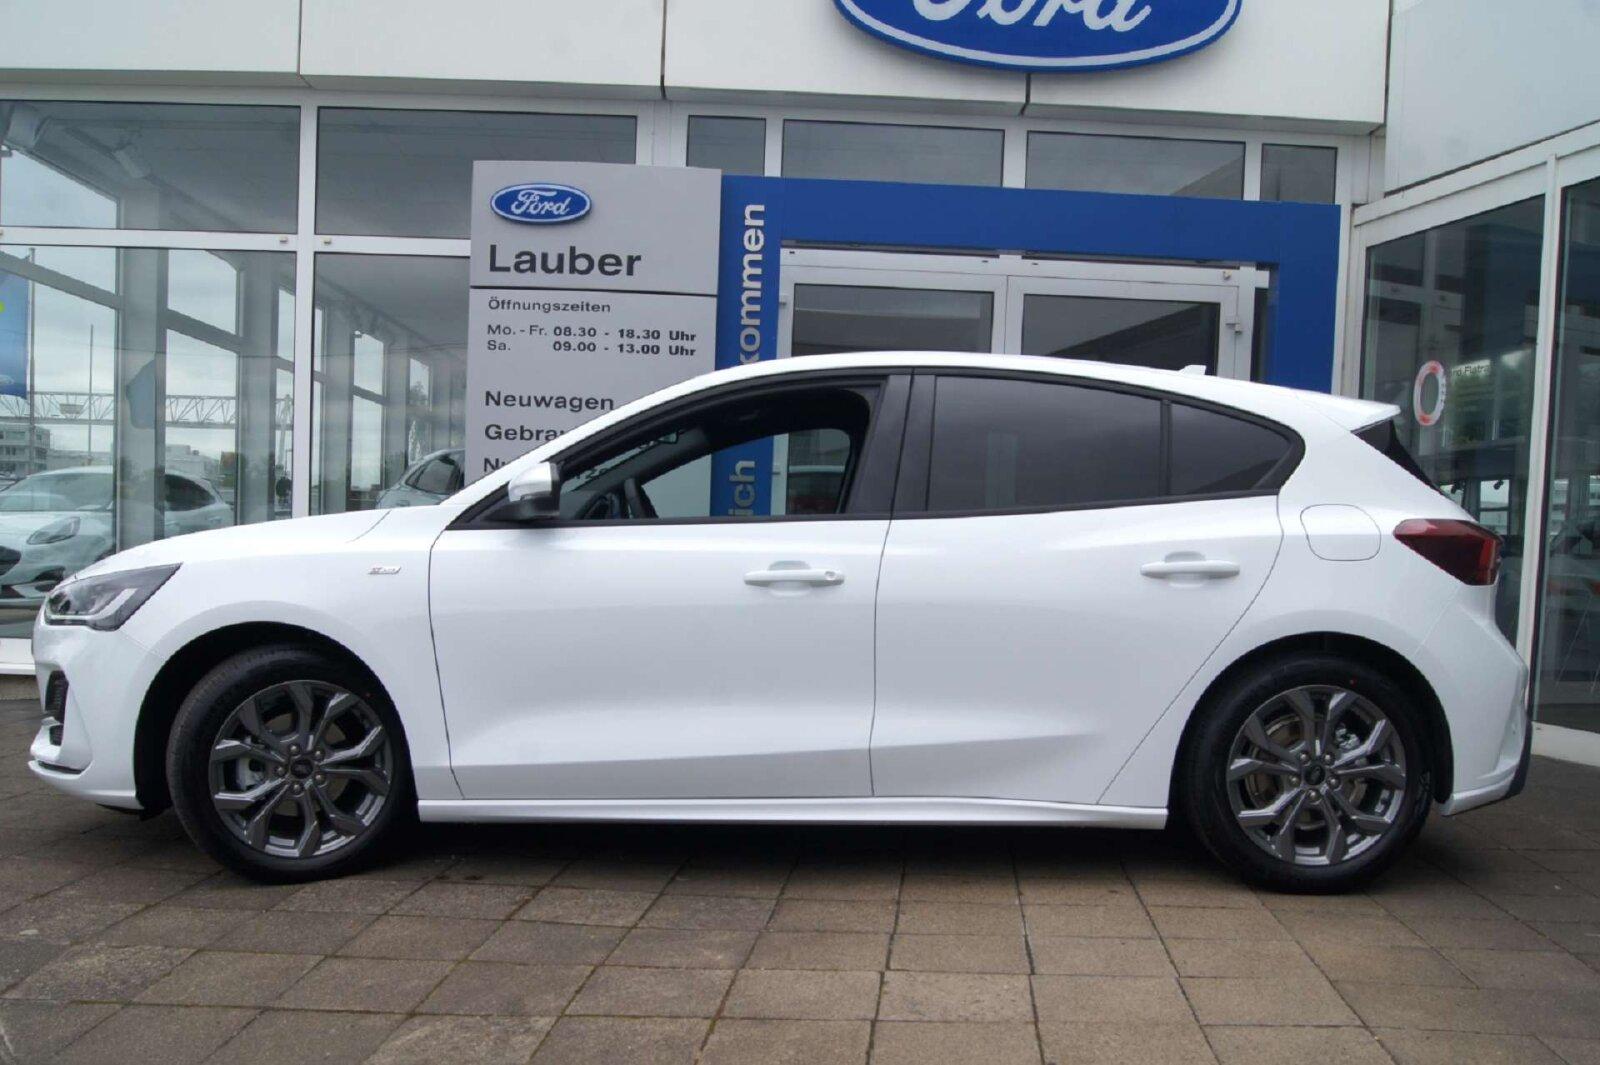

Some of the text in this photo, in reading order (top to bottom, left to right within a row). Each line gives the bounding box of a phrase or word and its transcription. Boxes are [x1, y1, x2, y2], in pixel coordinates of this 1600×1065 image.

[511, 189, 572, 215] Ford
[489, 244, 642, 276] Lauber
[487, 296, 611, 313] Öffnungszeiten
[553, 326, 597, 338] 08.30
[618, 328, 661, 340] 18.30
[668, 330, 697, 342] Uhr
[487, 340, 512, 351] Sa.
[552, 341, 597, 352] 09.00
[618, 343, 661, 355] 13.00
[668, 345, 697, 357] Uhr
[485, 390, 615, 413] Neuwagen
[484, 424, 564, 441] Gebra
